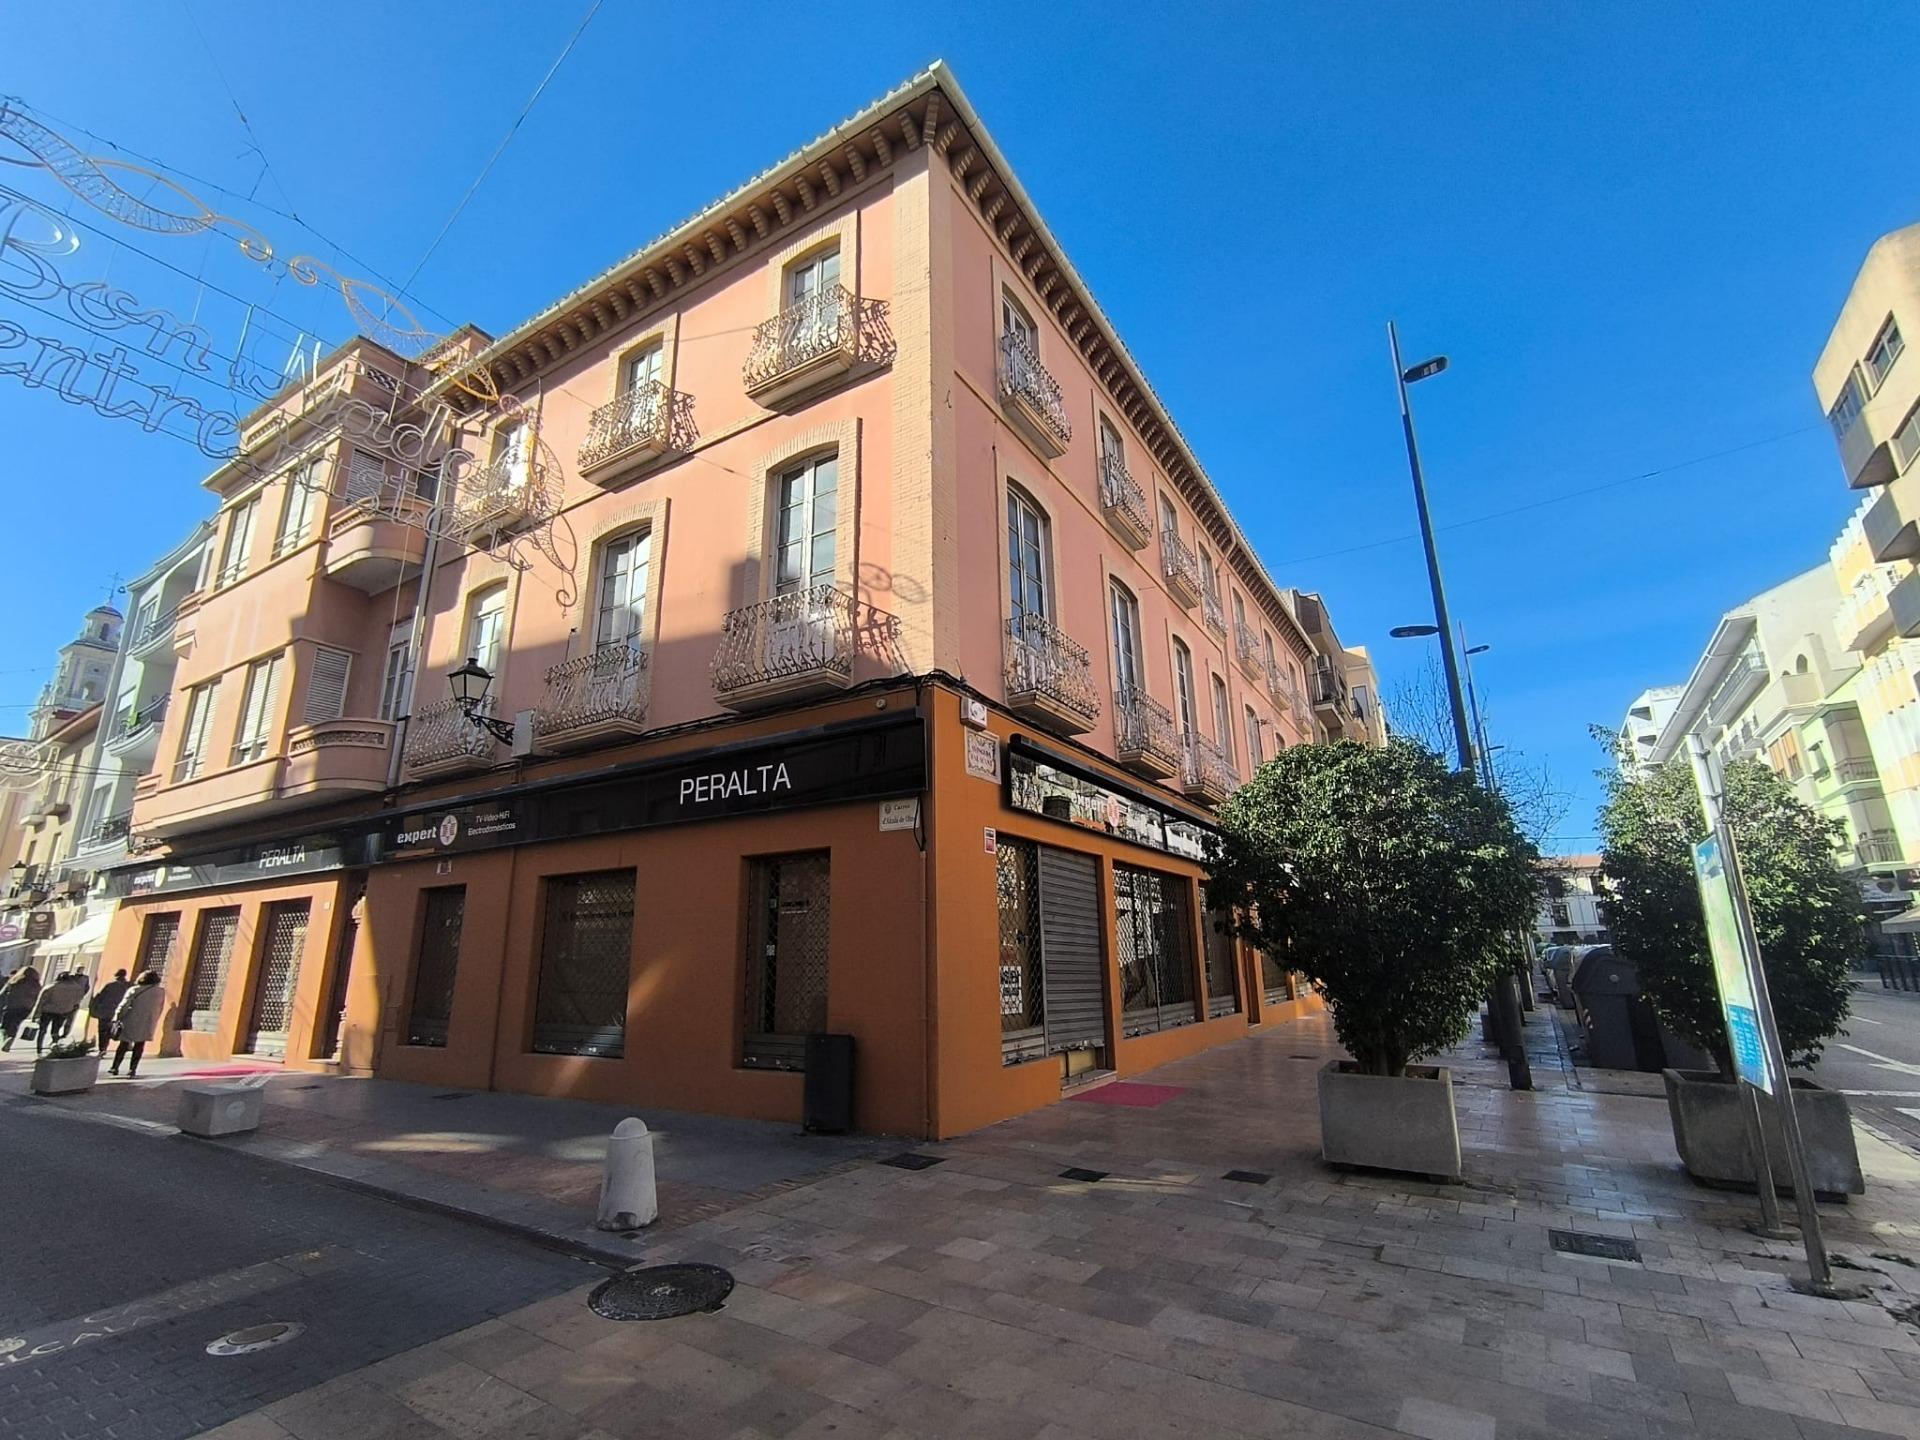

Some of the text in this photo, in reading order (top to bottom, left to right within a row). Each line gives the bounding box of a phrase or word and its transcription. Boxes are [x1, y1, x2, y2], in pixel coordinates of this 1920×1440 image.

[680, 762, 792, 805] PERALTA
[397, 827, 437, 844] expert
[258, 845, 305, 869] PERALTA
